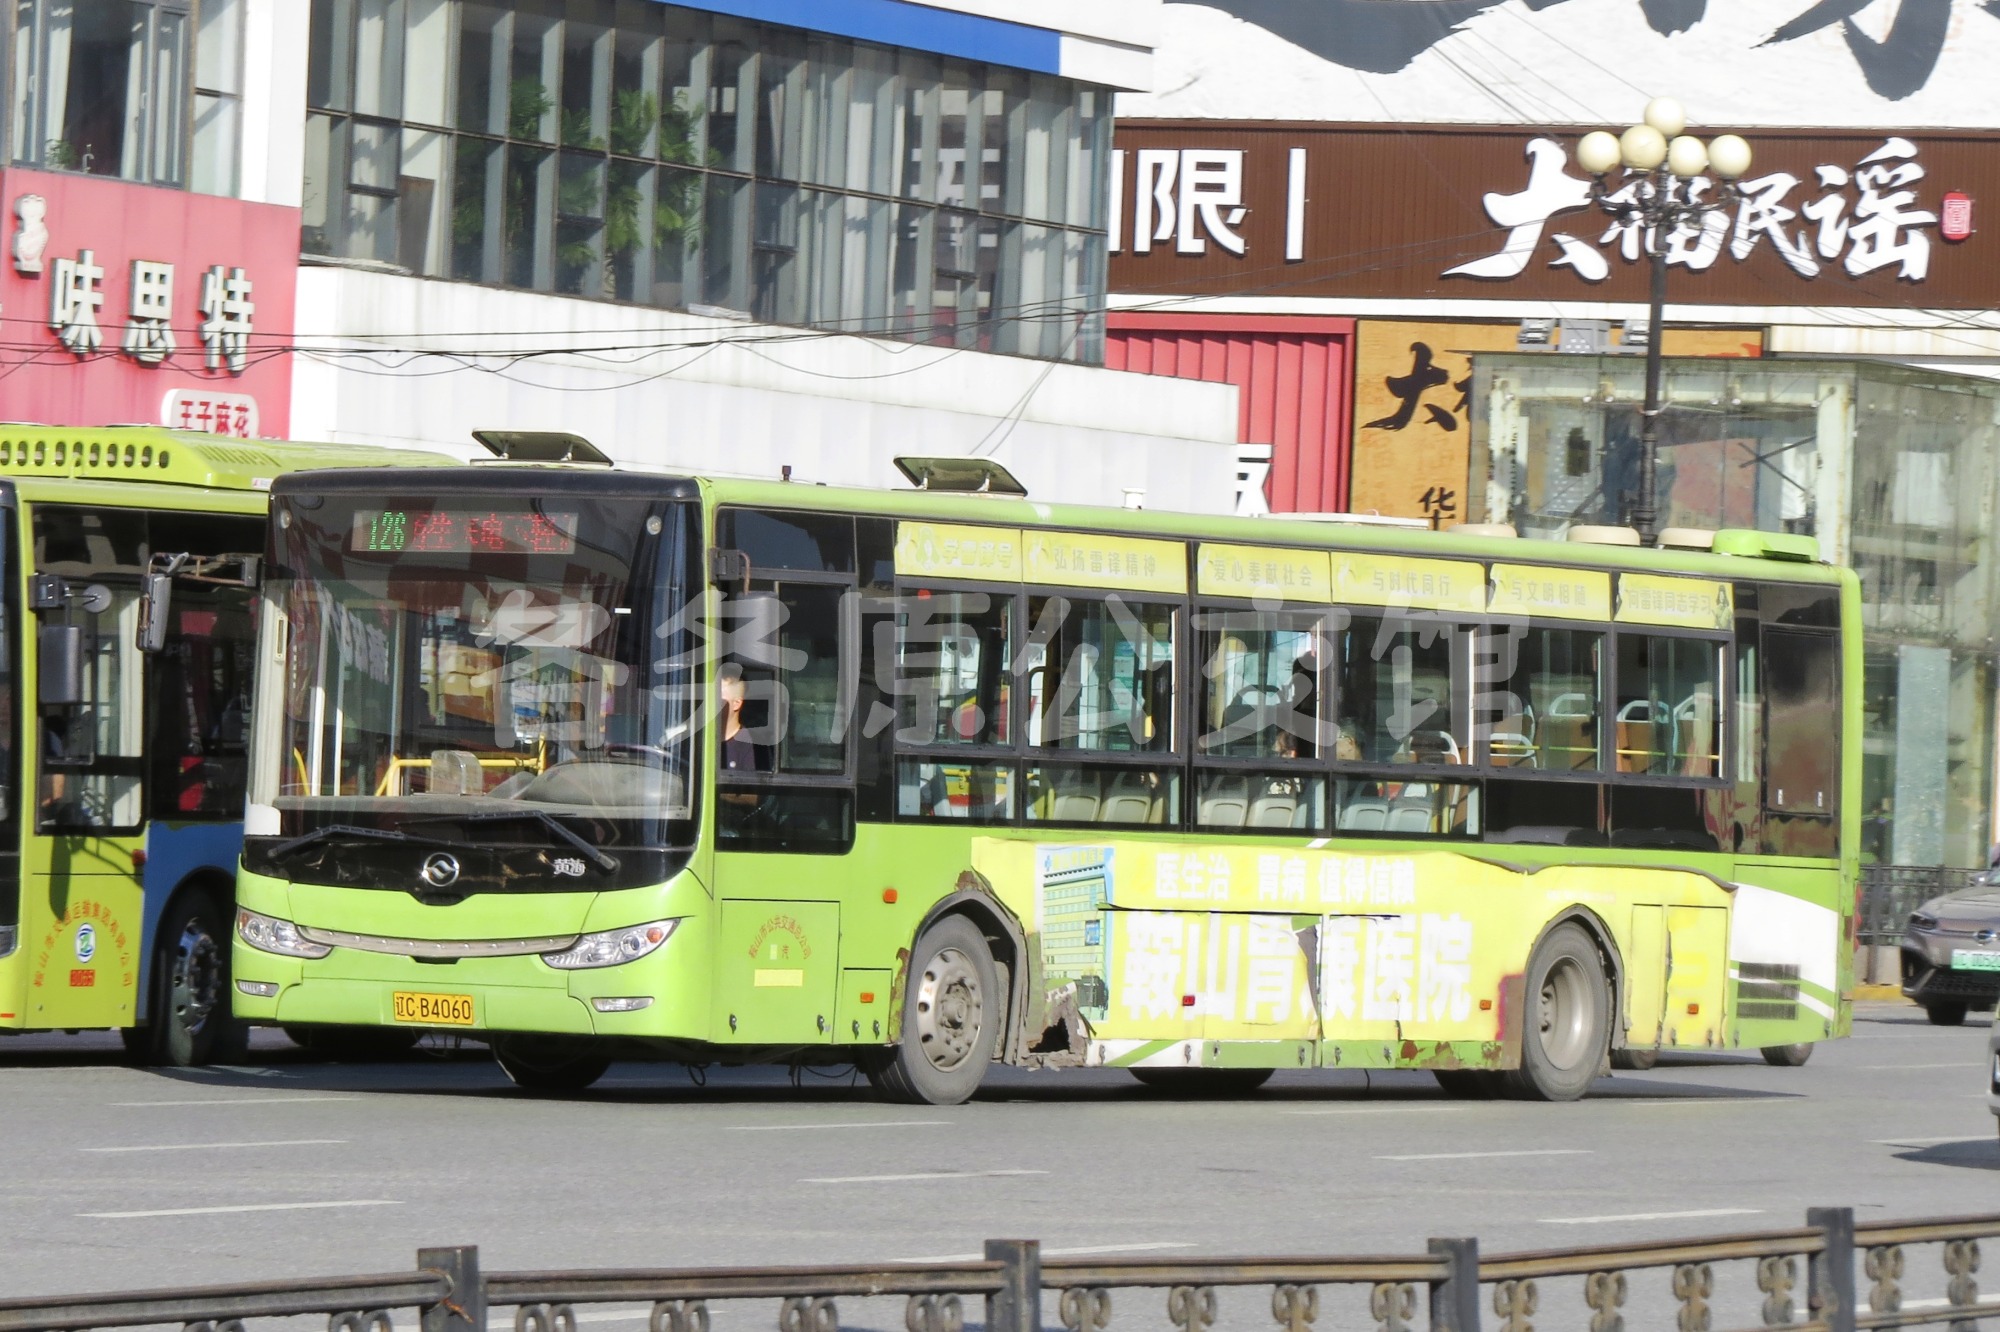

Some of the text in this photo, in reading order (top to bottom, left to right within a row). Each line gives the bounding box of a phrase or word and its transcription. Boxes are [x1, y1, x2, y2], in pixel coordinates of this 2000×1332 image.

[1107, 148, 1247, 255] 限
[1361, 341, 1472, 432] 大
[180, 400, 249, 438] 王子麻花
[1053, 547, 1157, 578] 弘扬雷锋精神
[1213, 558, 1313, 587] 爱心奉献社会
[1371, 569, 1451, 597] 与时代同行
[1510, 579, 1587, 607] 与文明相随
[1627, 587, 1712, 615] 向雷锋同志学习
[553, 857, 587, 878] 黄海
